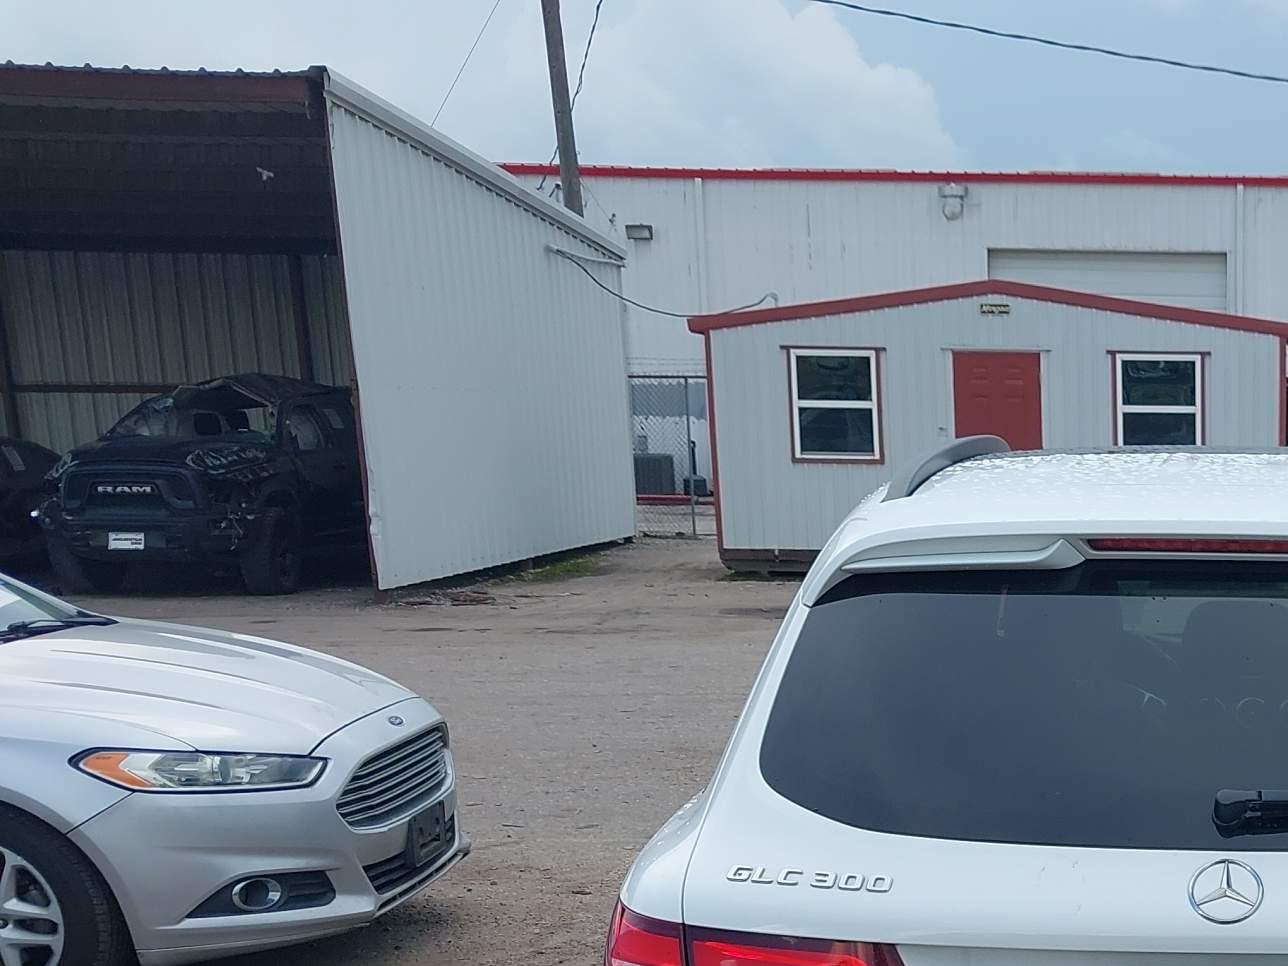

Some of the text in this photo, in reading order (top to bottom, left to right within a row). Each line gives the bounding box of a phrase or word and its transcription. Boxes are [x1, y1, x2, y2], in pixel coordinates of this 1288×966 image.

[97, 486, 152, 494] RAM
[726, 864, 894, 893] GLC 300
